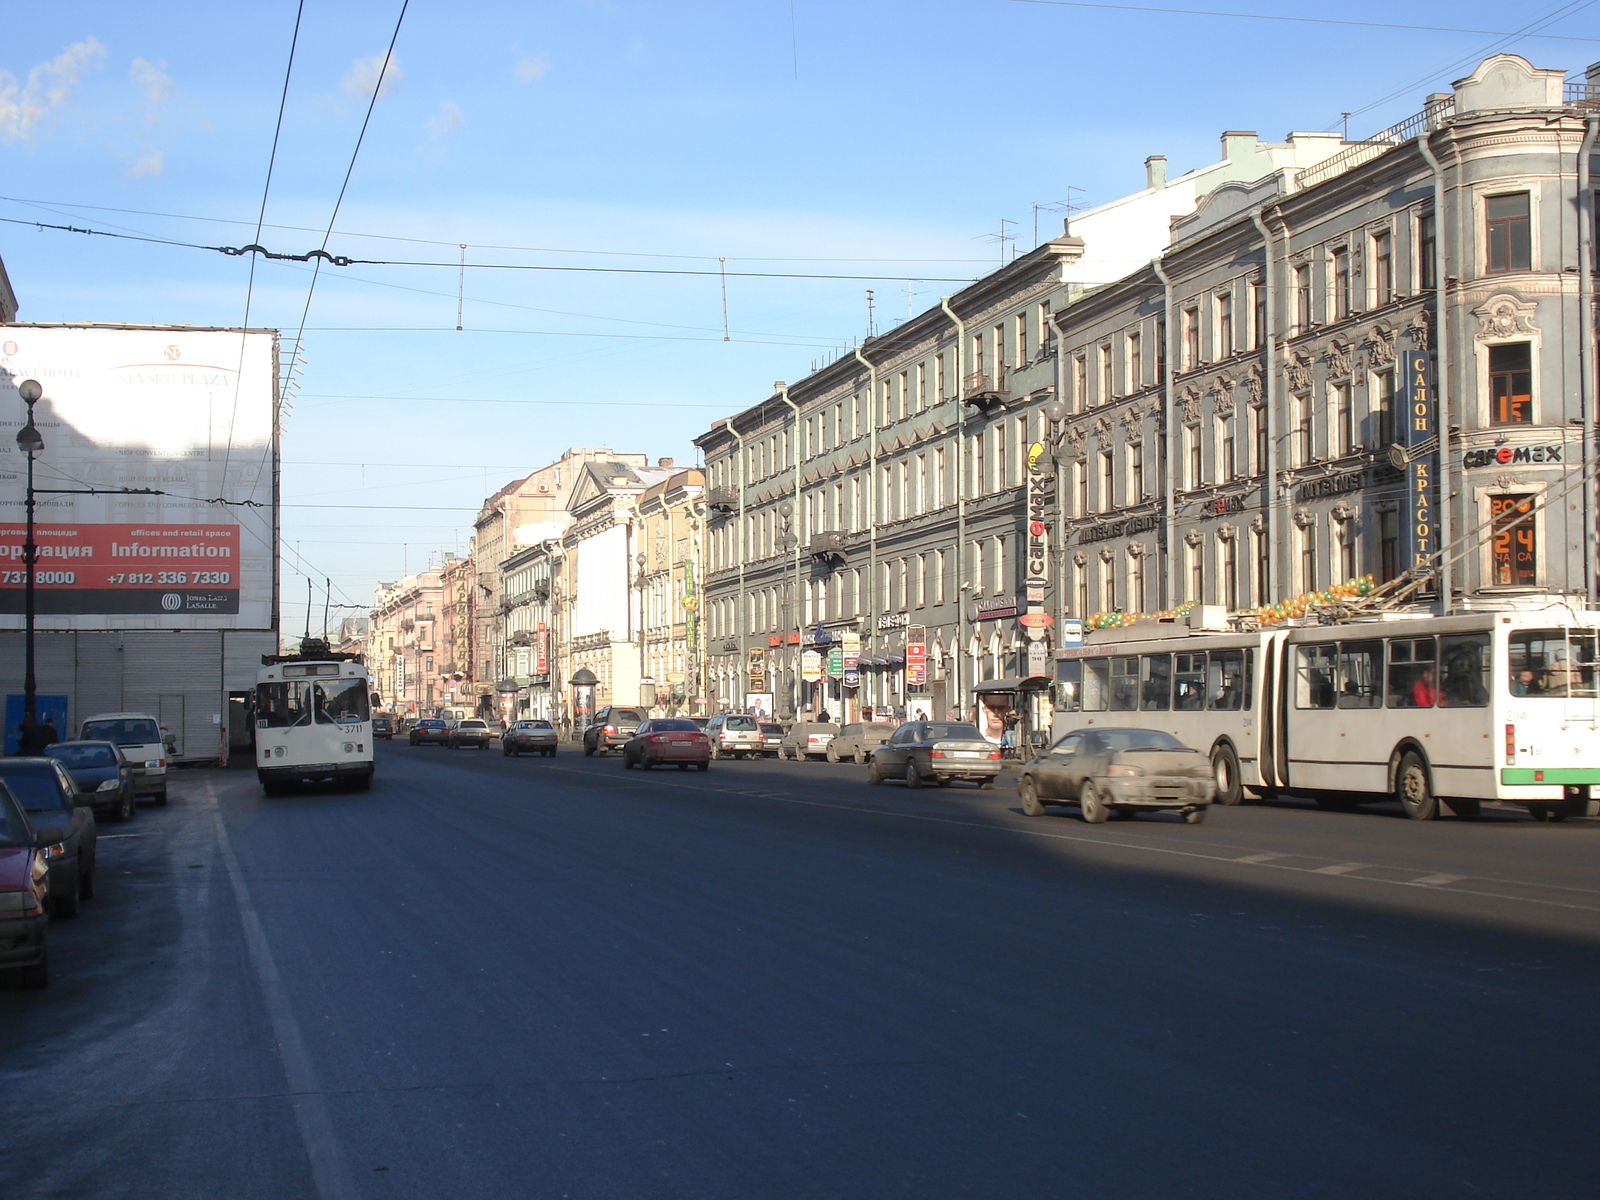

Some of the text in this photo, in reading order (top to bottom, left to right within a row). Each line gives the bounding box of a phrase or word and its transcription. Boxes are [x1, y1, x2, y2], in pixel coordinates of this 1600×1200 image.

[1414, 358, 1427, 431] САЛОН
[1415, 464, 1431, 567] КРАСОТЫ
[131, 529, 160, 537] offices
[162, 529, 178, 537] and
[180, 529, 203, 537] retail
[111, 542, 230, 558] Information
[36, 571, 75, 585] 8000
[107, 571, 230, 585] +7 812 336 7330
[344, 724, 363, 734] 3711
